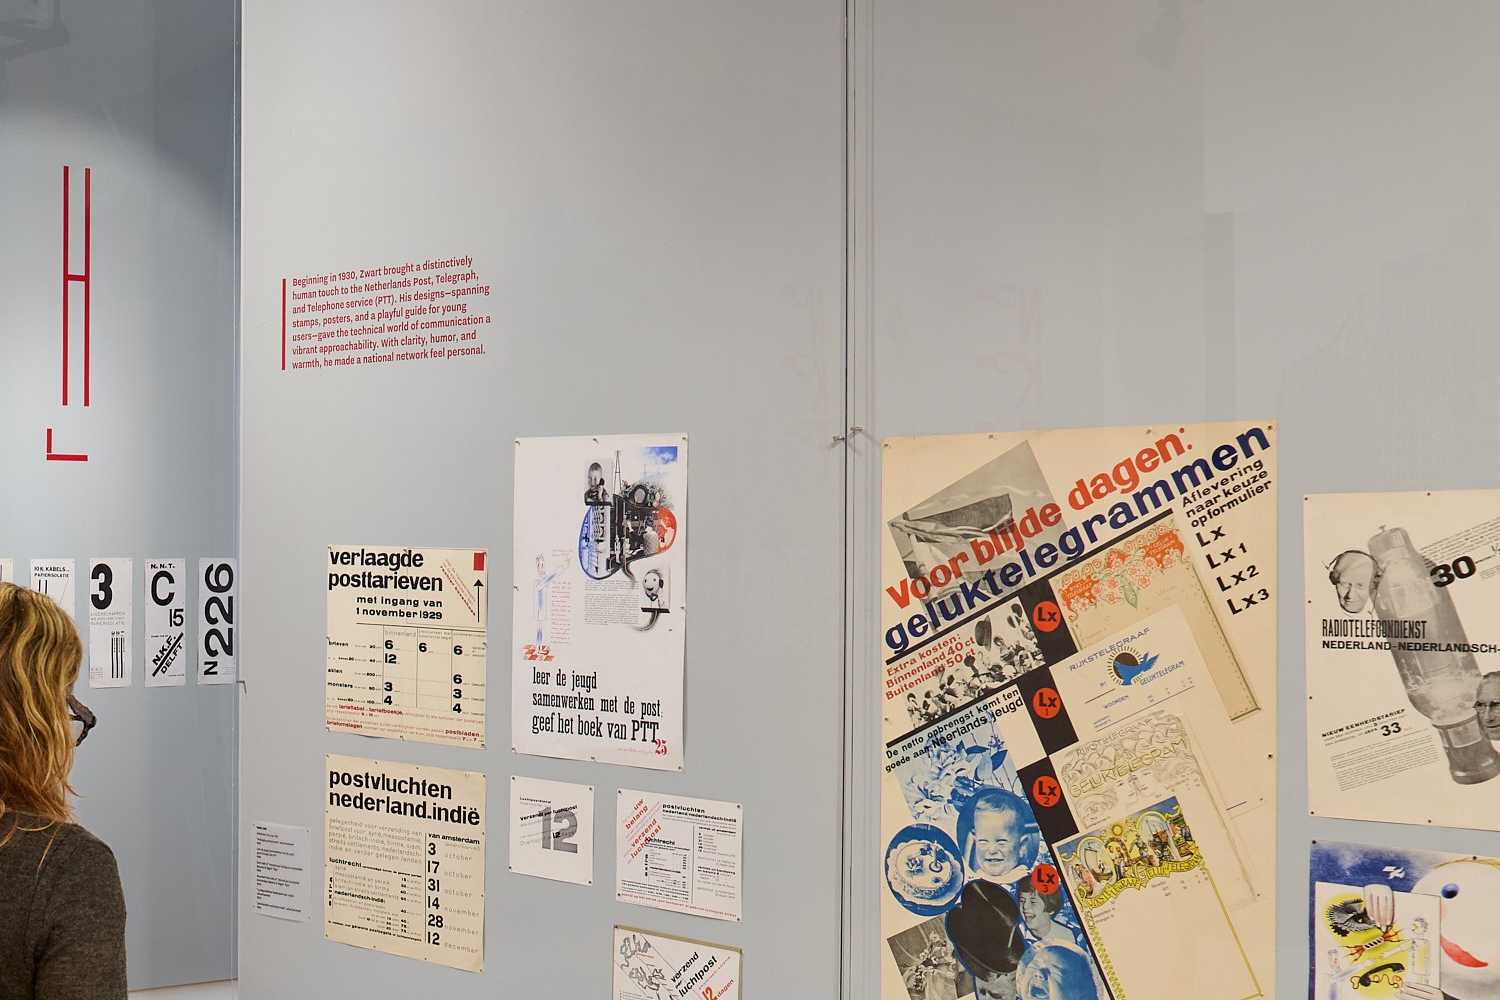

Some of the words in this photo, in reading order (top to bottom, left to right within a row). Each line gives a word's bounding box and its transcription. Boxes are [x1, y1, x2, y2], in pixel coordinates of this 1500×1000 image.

[293, 274, 328, 288] Beginning
[330, 273, 336, 281] in
[338, 271, 357, 280] 1930,
[360, 268, 381, 278] Zwart
[384, 263, 414, 275] brought
[423, 255, 472, 270] distinctively
[293, 291, 316, 300] human
[319, 286, 339, 297] touch
[351, 281, 362, 292] the
[365, 278, 411, 292] Netherlands
[414, 276, 433, 286] Post,
[436, 270, 478, 284] Telegraph,
[293, 304, 305, 314] and
[307, 301, 344, 313] Telephone
[346, 297, 373, 308] service
[375, 294, 398, 307] (PTT).
[400, 292, 411, 302] His
[414, 284, 490, 301] designs—spanning
[293, 319, 320, 328] stamps,
[323, 316, 352, 327] posters,
[355, 311, 368, 321] and
[378, 307, 403, 321] playful
[405, 305, 426, 319] guide
[429, 304, 440, 313] for
[442, 303, 467, 315] young
[293, 331, 334, 341] users—gave
[337, 328, 348, 337] the
[351, 324, 385, 333] technical
[387, 321, 408, 332] world
[411, 320, 418, 330] of
[421, 315, 483, 329] communication
[292, 346, 317, 355] vibrant
[319, 339, 379, 355] approachability.
[381, 337, 398, 347] With
[401, 335, 427, 346] clarity,
[430, 334, 458, 343] humor,
[461, 330, 476, 340] and
[292, 358, 321, 369] warmth,
[324, 357, 332, 366] he
[335, 355, 354, 365] made
[363, 352, 394, 363] national
[396, 349, 428, 360] network
[430, 348, 445, 358] feel
[448, 344, 485, 359] personal.
[1182, 459, 1263, 508] Aflevering
[1223, 471, 1268, 498] keuze
[886, 551, 969, 610] Voor
[970, 503, 1062, 566] blijde
[1068, 427, 1193, 510] dagen:
[886, 426, 1271, 654] geluktelegrammen
[330, 549, 423, 571] verlaagde
[1430, 556, 1476, 588] 30
[91, 563, 112, 610] 3
[151, 570, 175, 606] C
[329, 571, 443, 591] posttarieven
[357, 596, 377, 604] met
[381, 596, 419, 608] ingang
[362, 608, 418, 618] november
[420, 611, 442, 620] 1929
[170, 608, 184, 627] 15
[1322, 619, 1427, 639] RADIOTELEFOONDIENST
[153, 635, 176, 666] N.K.F.
[161, 643, 183, 674] DELFT
[886, 653, 946, 688] Binnenland
[947, 642, 963, 656] 40
[965, 636, 975, 646] ct
[887, 658, 917, 677] Extra
[919, 634, 961, 660] kosten:
[1069, 627, 1150, 672] RIJKSTELEGRAAF
[533, 667, 550, 685] leer
[556, 669, 566, 686] de
[572, 670, 597, 693] jeugd
[885, 664, 945, 700] Buitenland
[946, 654, 963, 668] 50
[965, 648, 976, 658] ct
[533, 692, 595, 711] samenwerken
[601, 696, 618, 713] met
[624, 696, 635, 714] de
[532, 713, 555, 734] geef
[558, 713, 573, 734] het
[578, 715, 602, 738] boek
[607, 722, 626, 740] van
[631, 720, 659, 742] PTT
[885, 755, 910, 773] goede
[913, 746, 929, 758] aan
[932, 714, 988, 748] Neerlands
[992, 698, 1024, 723] jeugd
[886, 747, 898, 759] De
[901, 735, 924, 753] netto
[928, 711, 974, 738] opbrengst
[977, 698, 1001, 713] komt
[1003, 689, 1019, 700] ten
[1322, 728, 1344, 738] NIEUW
[1345, 709, 1406, 730] EENHEIDSTARIEF
[1380, 722, 1402, 736] 33
[655, 739, 667, 756] 25
[329, 770, 451, 800] postvluchten
[329, 791, 480, 825] nederland.indië
[626, 805, 648, 830] belang
[442, 835, 480, 845] amsterdam
[631, 819, 657, 847] verzend
[444, 942, 478, 954] december
[671, 952, 699, 983] verzend
[679, 955, 717, 997] luchtpost
[717, 979, 734, 997] dagen
